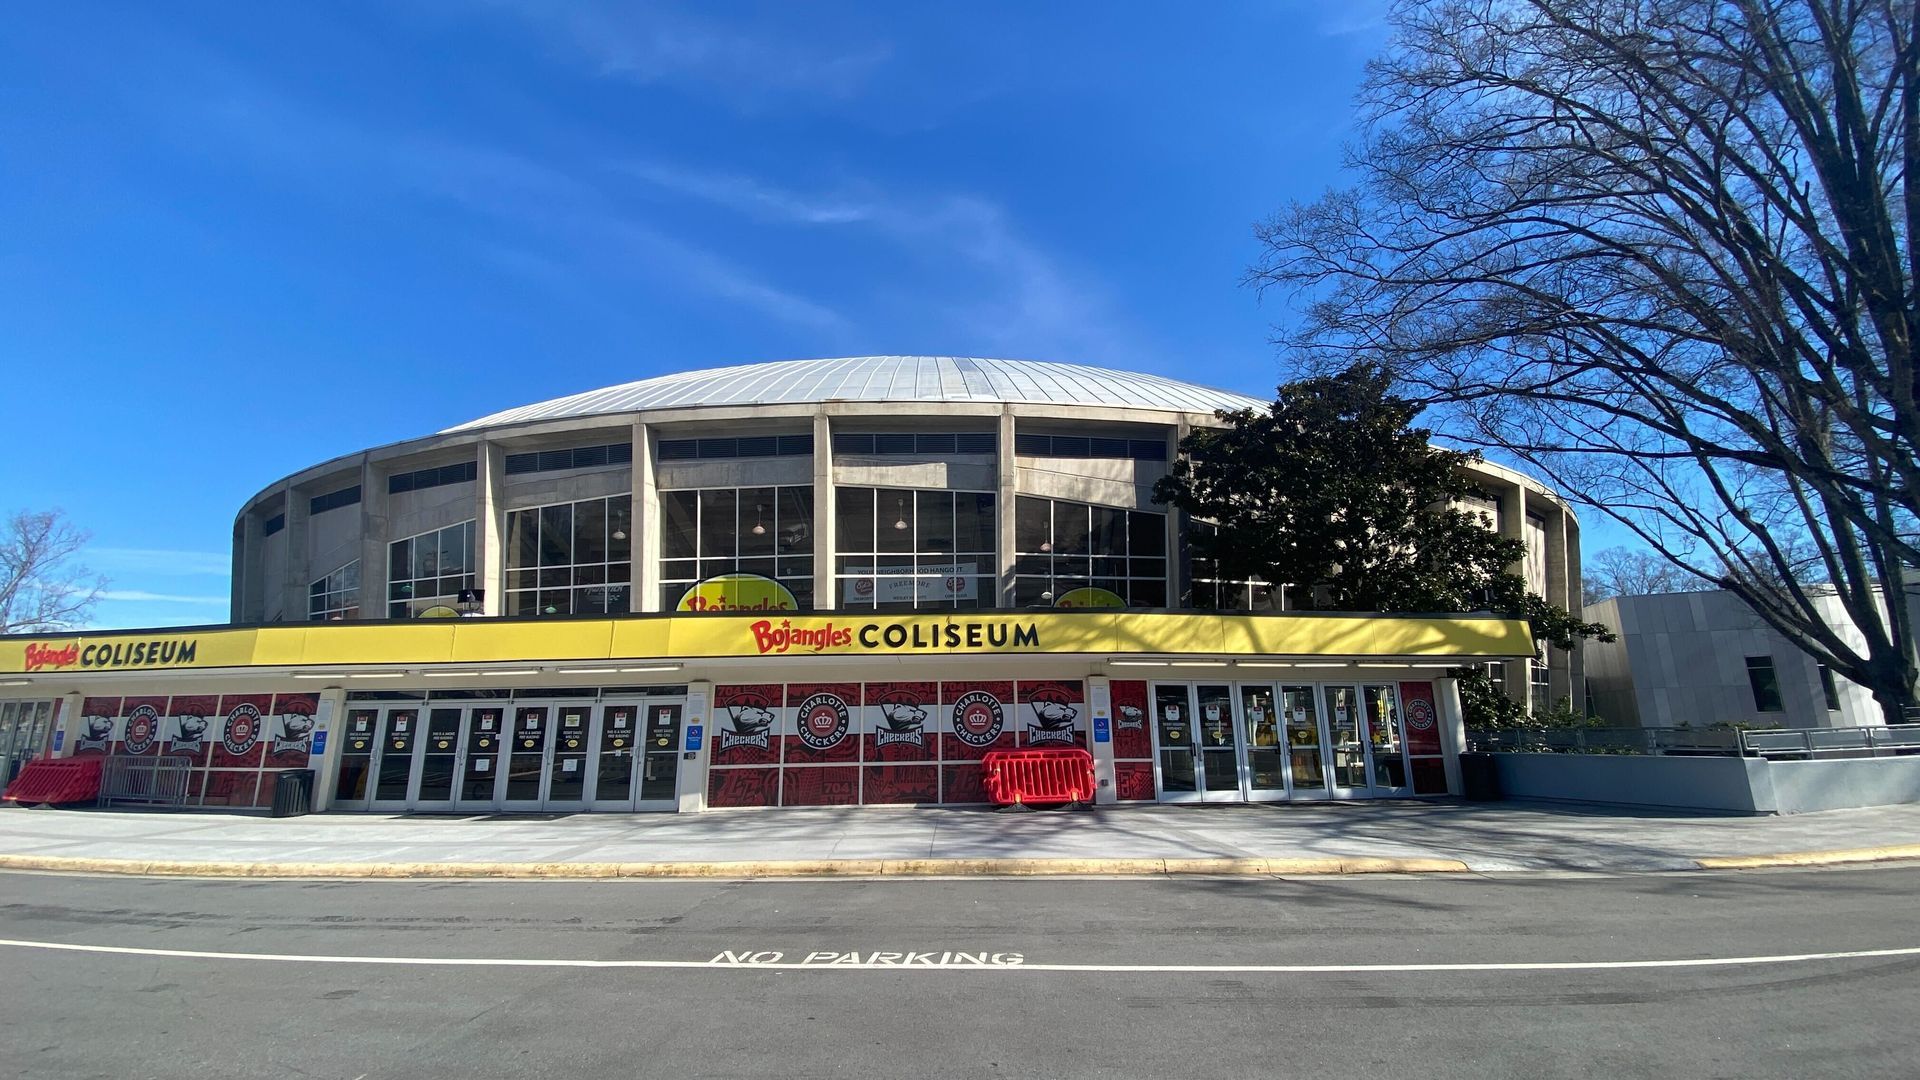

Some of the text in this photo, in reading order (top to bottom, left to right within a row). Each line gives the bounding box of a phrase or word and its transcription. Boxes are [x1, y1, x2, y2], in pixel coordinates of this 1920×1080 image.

[750, 619, 1040, 654] Bojangles COLISEUM
[25, 640, 197, 671] Bojangles COLISEUM
[800, 696, 847, 718] CHARLOTTE
[956, 694, 1000, 716] CHARLOTTE
[128, 708, 157, 727] CHARLOTTE
[227, 707, 260, 727] CHARLOTTE
[225, 733, 257, 752] CHECKERS
[721, 729, 769, 748] CHECKERS
[800, 725, 846, 746] CHECKERS
[877, 727, 923, 746] CHECKERS
[956, 723, 1000, 743] CHECKERS
[1029, 727, 1074, 744] CHECKERS
[708, 950, 1025, 965] NO PARKING
